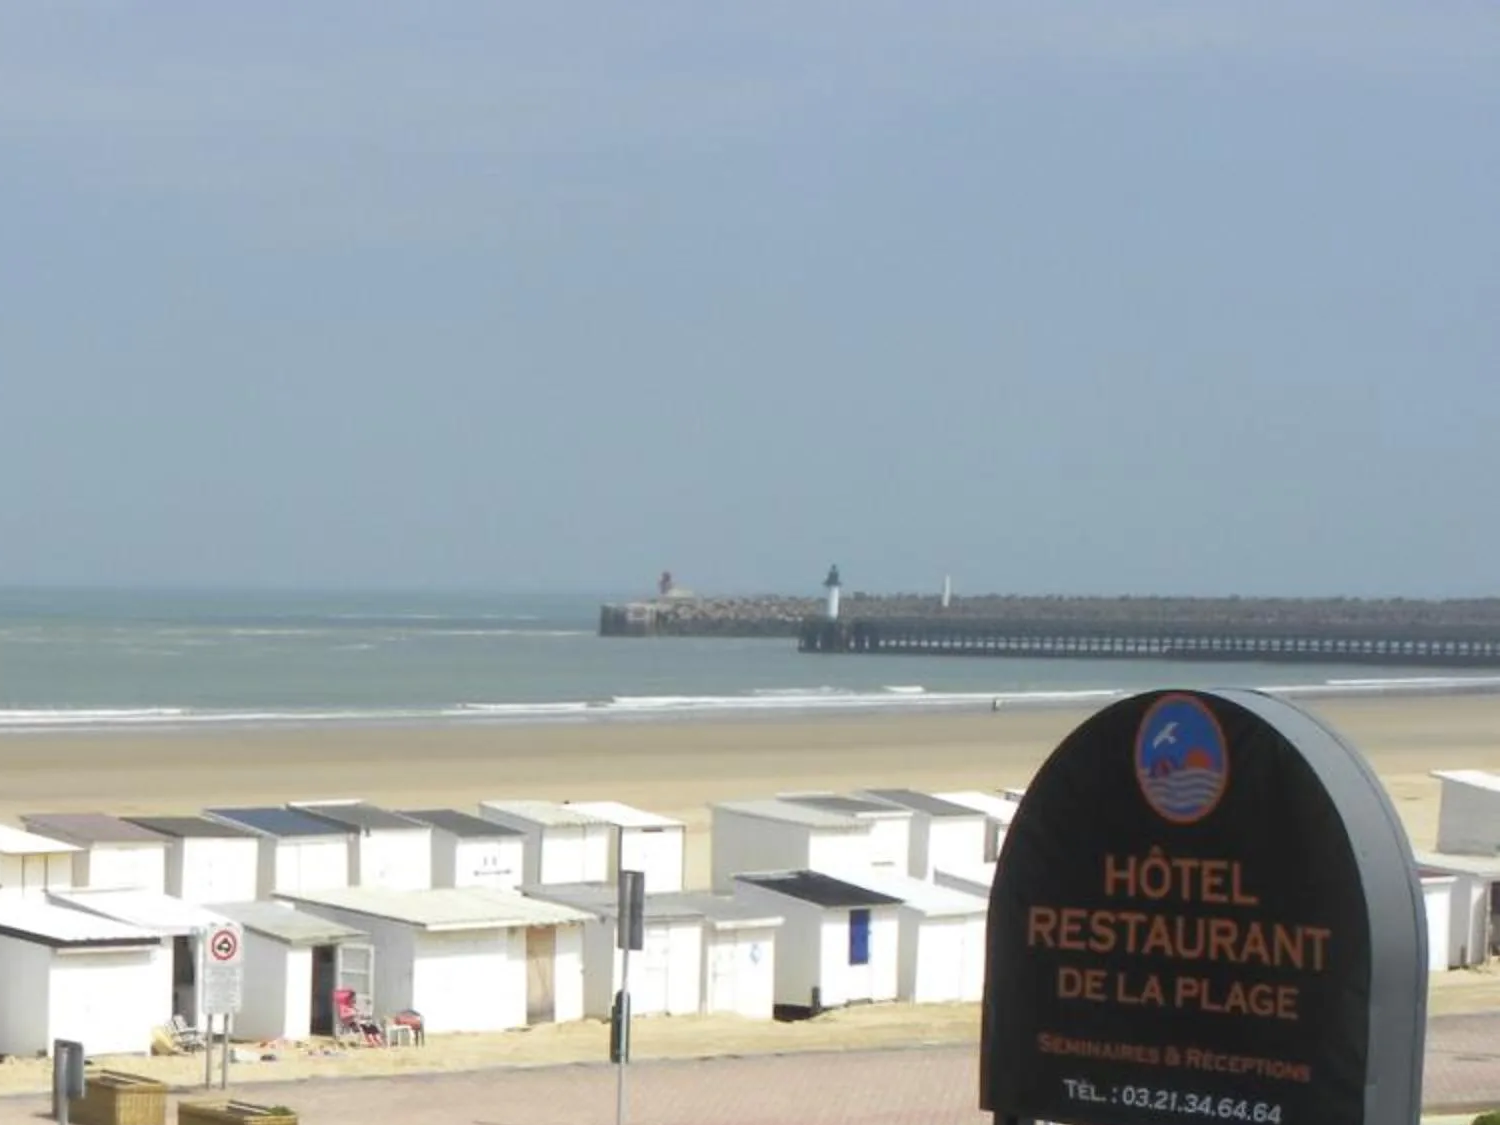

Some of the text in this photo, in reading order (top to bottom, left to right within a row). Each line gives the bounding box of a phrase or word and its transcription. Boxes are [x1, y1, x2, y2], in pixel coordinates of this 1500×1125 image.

[1104, 846, 1259, 905] HÔTEL
[1028, 906, 1332, 971] RESTAURANT
[1058, 967, 1299, 1020] DE LA PLAGE
[1121, 1086, 1283, 1125] 03.21.34.64.64
